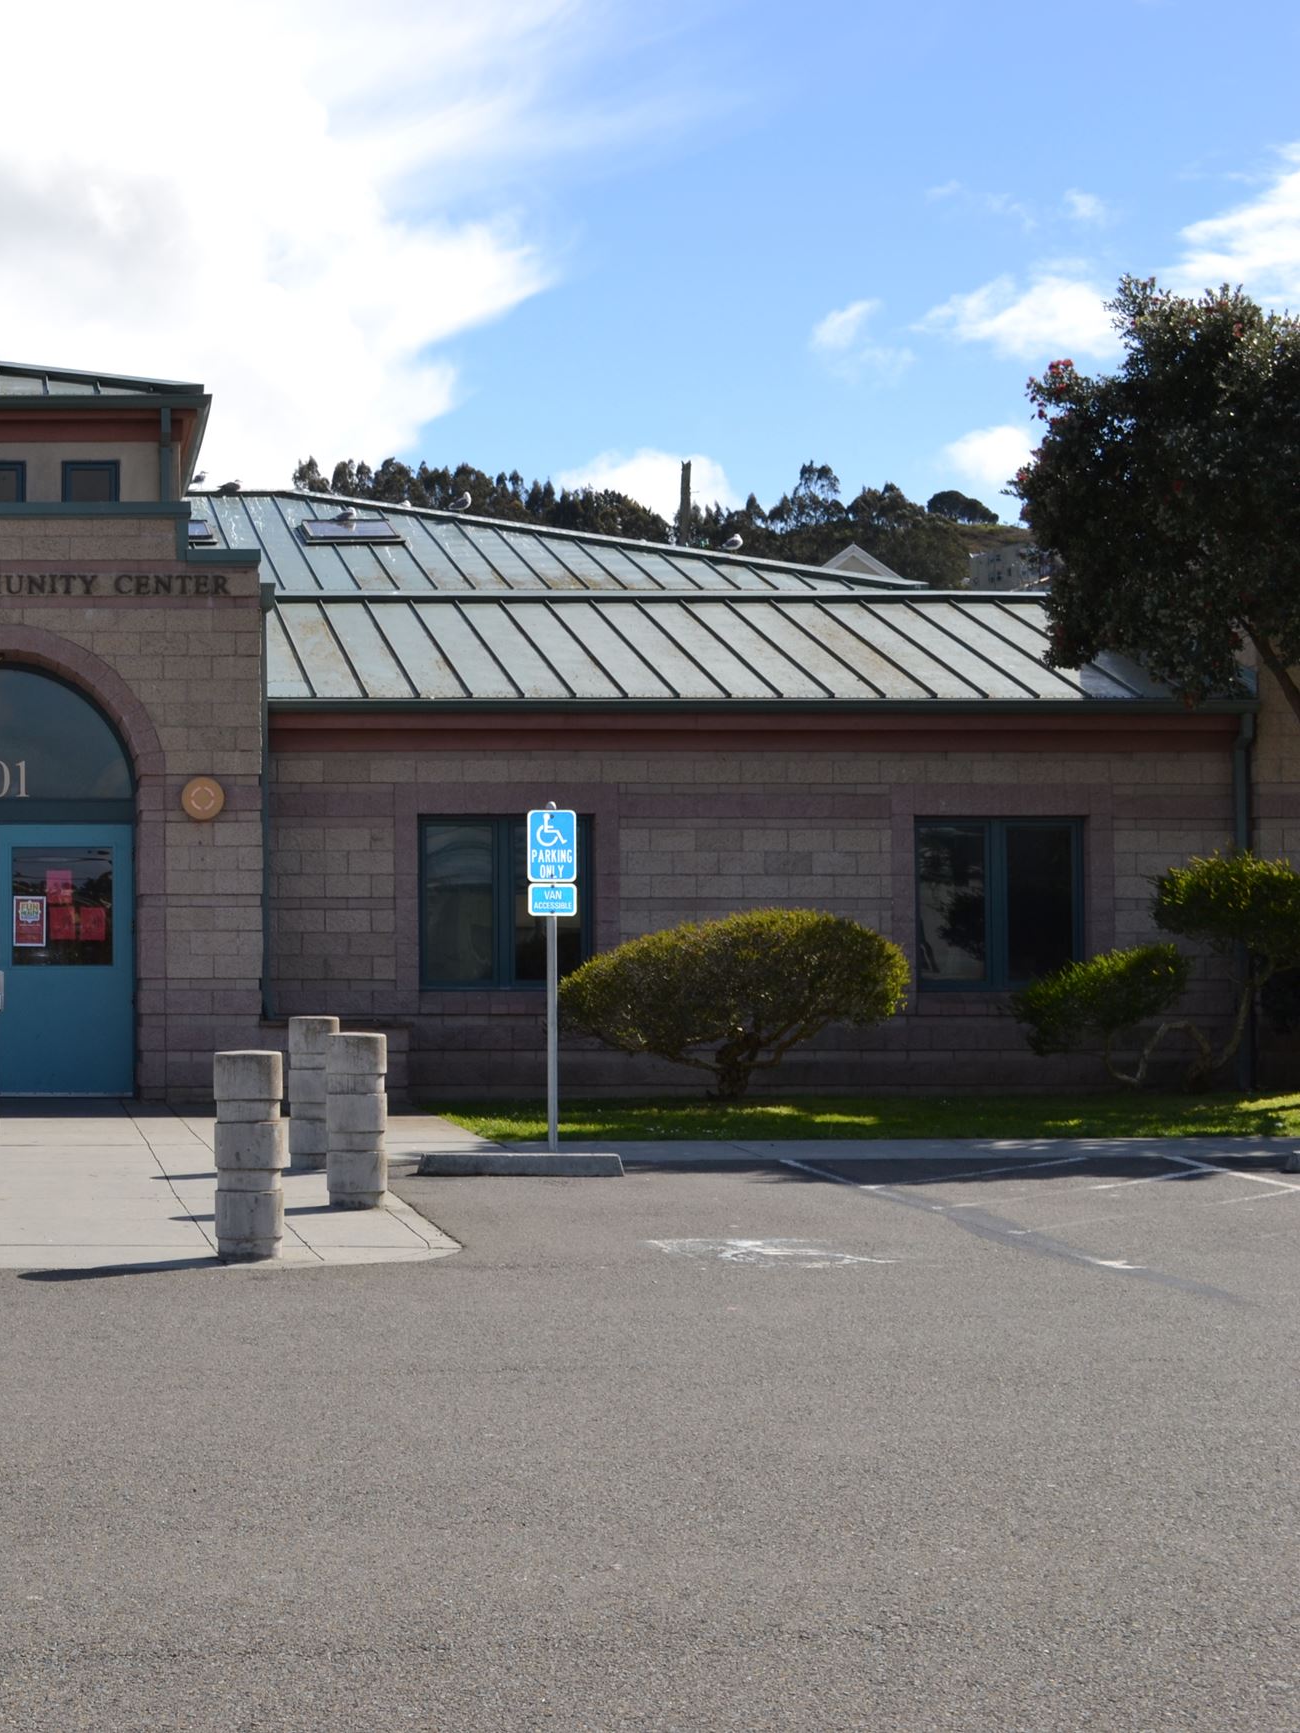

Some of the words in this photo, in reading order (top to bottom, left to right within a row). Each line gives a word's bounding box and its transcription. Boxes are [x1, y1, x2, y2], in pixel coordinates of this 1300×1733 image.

[114, 574, 230, 596] CENTER
[531, 849, 573, 864] PARKING
[540, 864, 565, 879] ONLY
[544, 890, 562, 900] VAN
